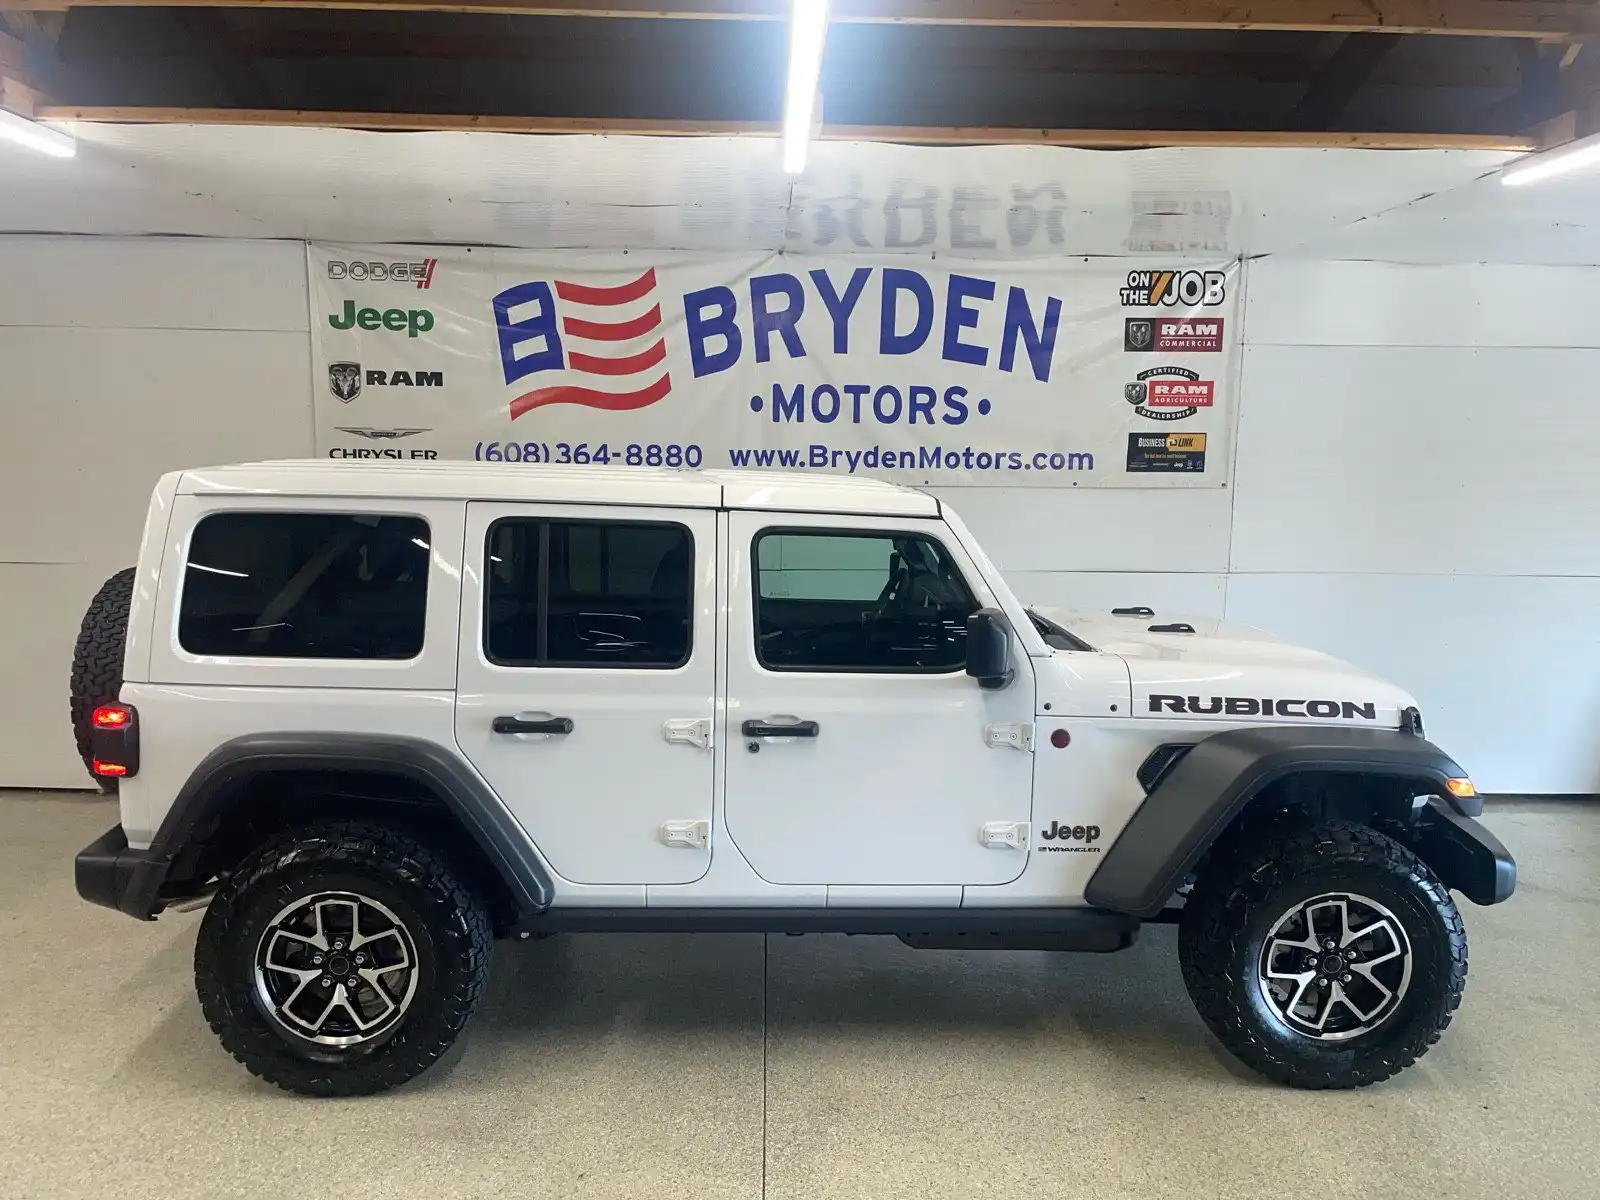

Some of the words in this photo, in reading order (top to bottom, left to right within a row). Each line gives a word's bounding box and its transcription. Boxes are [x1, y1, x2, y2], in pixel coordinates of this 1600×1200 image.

[327, 260, 427, 282] DODGE
[1127, 270, 1150, 288] ON
[1120, 288, 1150, 305] THE
[1160, 270, 1225, 306] JOB
[328, 299, 434, 338] Jeep
[683, 267, 1063, 383] BRYDEN
[1160, 324, 1218, 335] RAM
[365, 369, 444, 387] RAM
[1147, 367, 1189, 376] CERTIFIED
[1154, 385, 1208, 395] RAM
[771, 383, 970, 426] MOTORS
[1141, 408, 1191, 419] DEALERSHIP
[729, 445, 1095, 474] www.BrydenMotors.com
[1148, 693, 1376, 720] RUBICON
[1041, 820, 1101, 844] Jeep
